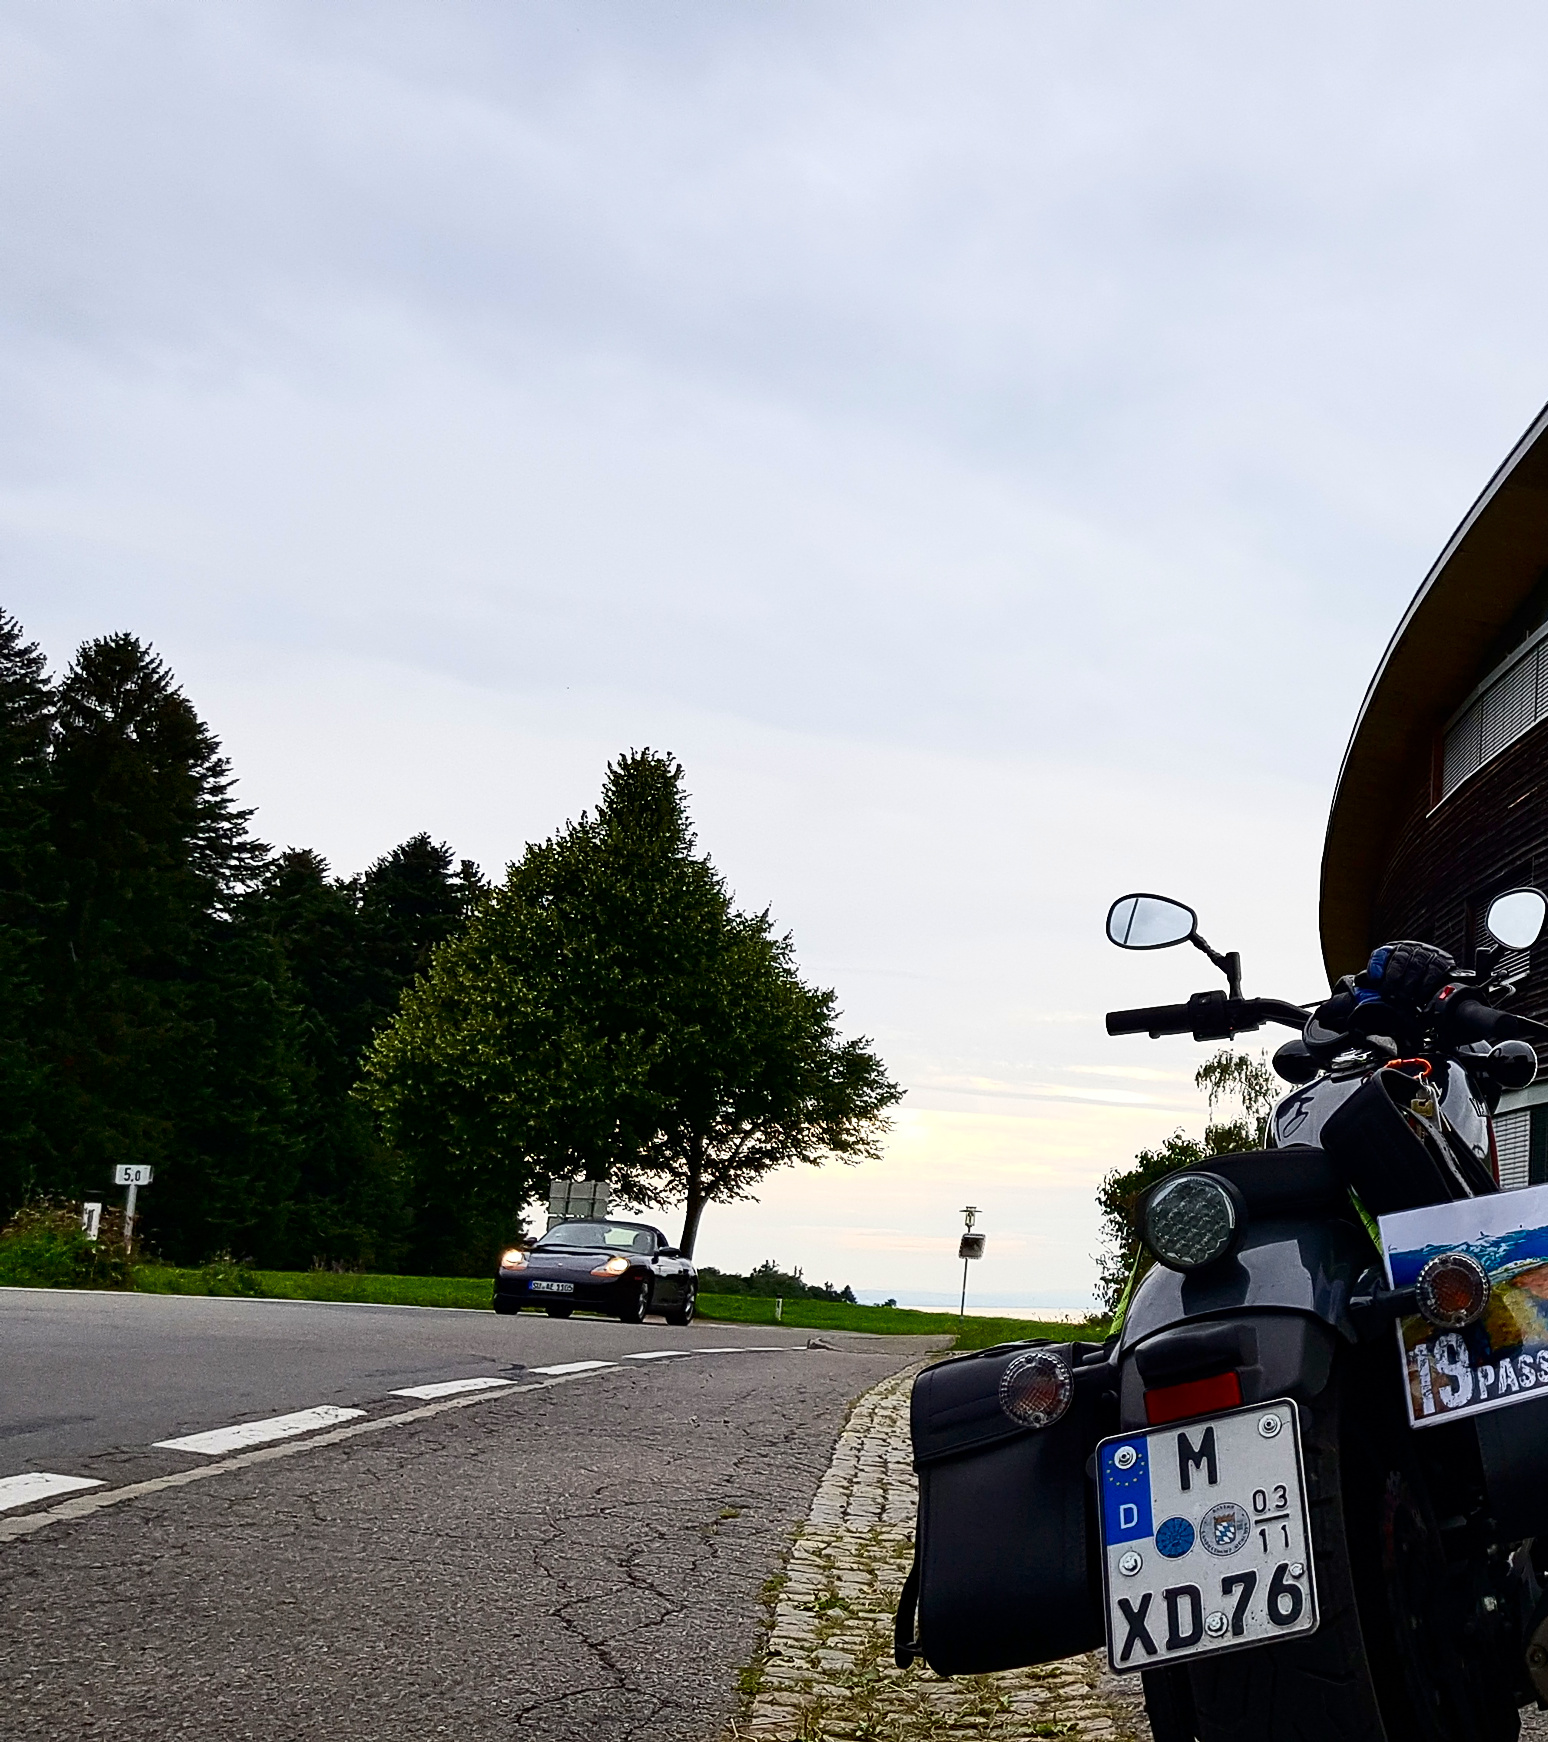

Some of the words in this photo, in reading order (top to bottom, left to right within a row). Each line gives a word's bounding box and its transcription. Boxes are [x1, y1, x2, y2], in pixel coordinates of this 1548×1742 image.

[123, 1167, 141, 1182] 5.0
[1177, 1426, 1218, 1491] M
[1119, 1503, 1139, 1530] D
[1258, 1524, 1290, 1553] 11
